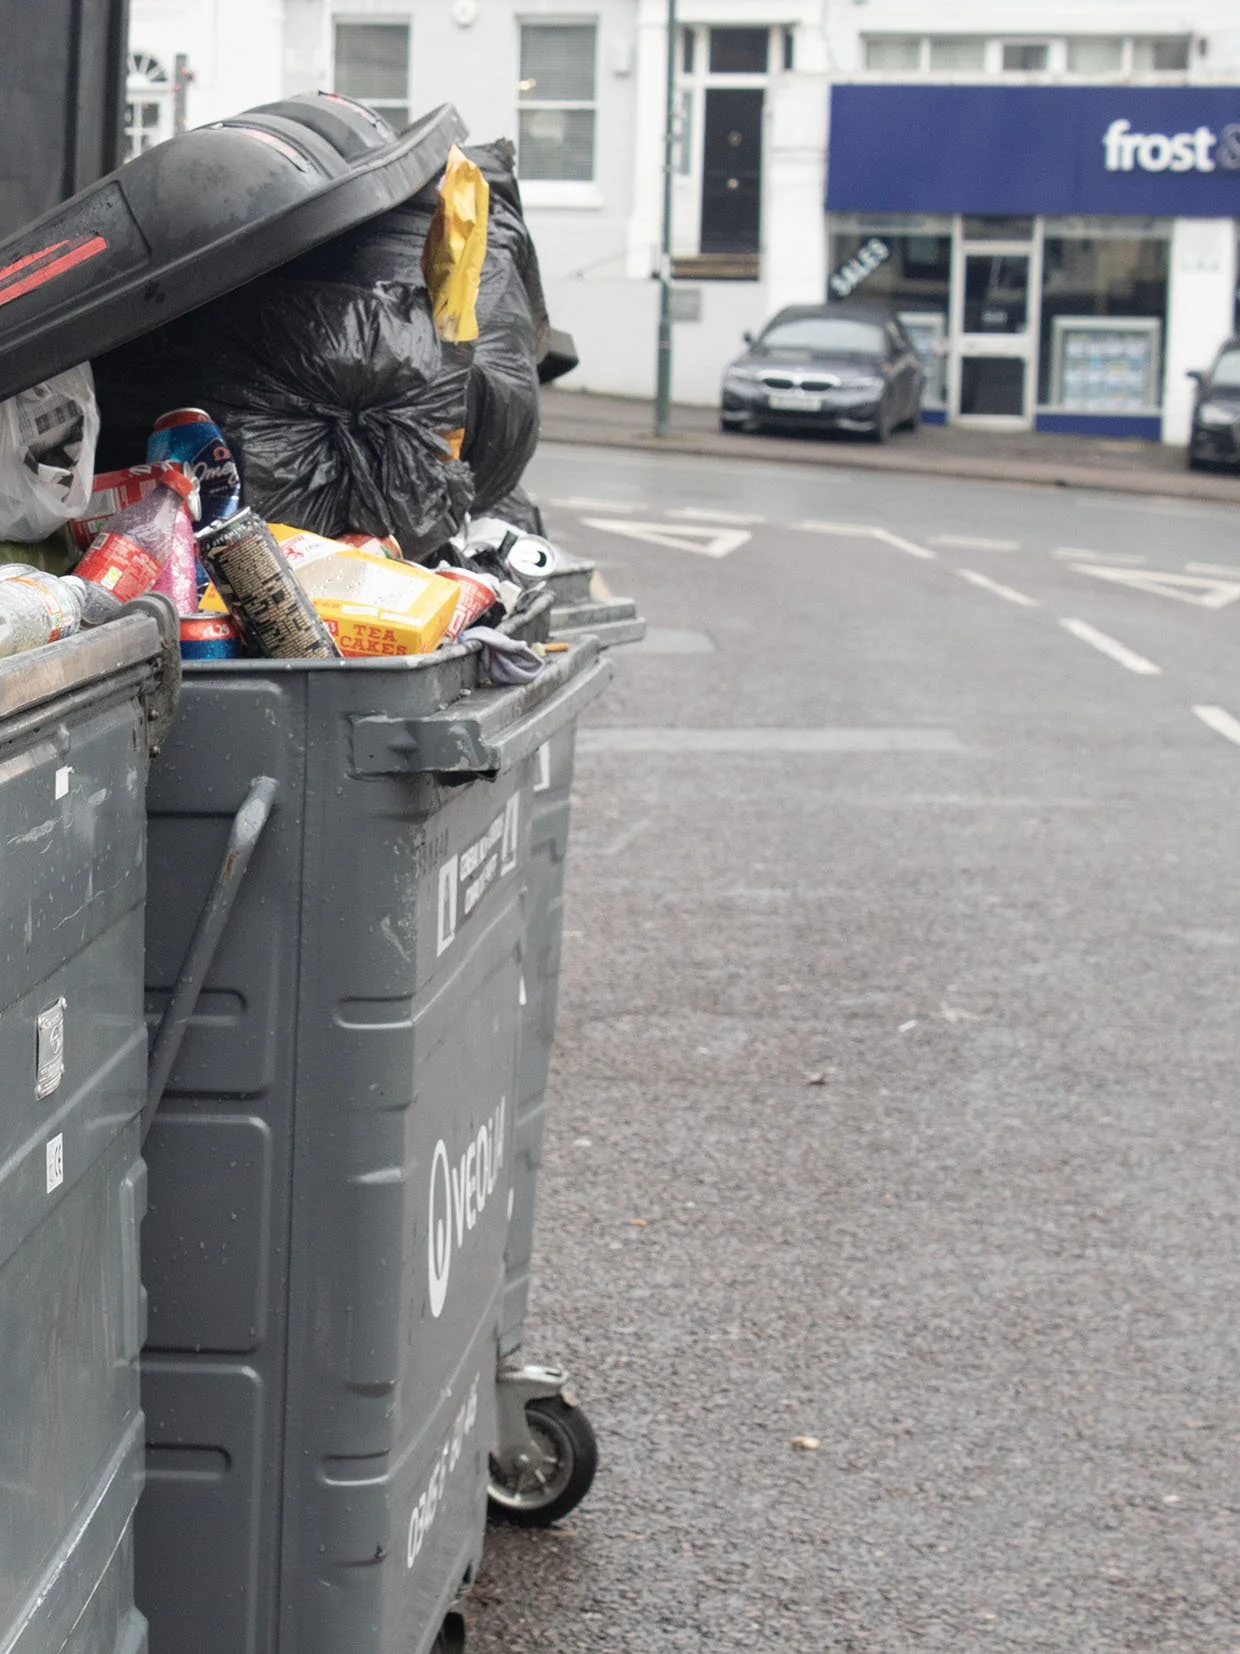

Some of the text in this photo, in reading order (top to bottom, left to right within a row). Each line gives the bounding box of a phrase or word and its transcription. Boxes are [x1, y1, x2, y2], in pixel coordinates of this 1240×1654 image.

[1103, 118, 1216, 172] frost
[831, 239, 889, 296] SALES
[340, 634, 407, 656] CAKES
[353, 623, 396, 642] TEA
